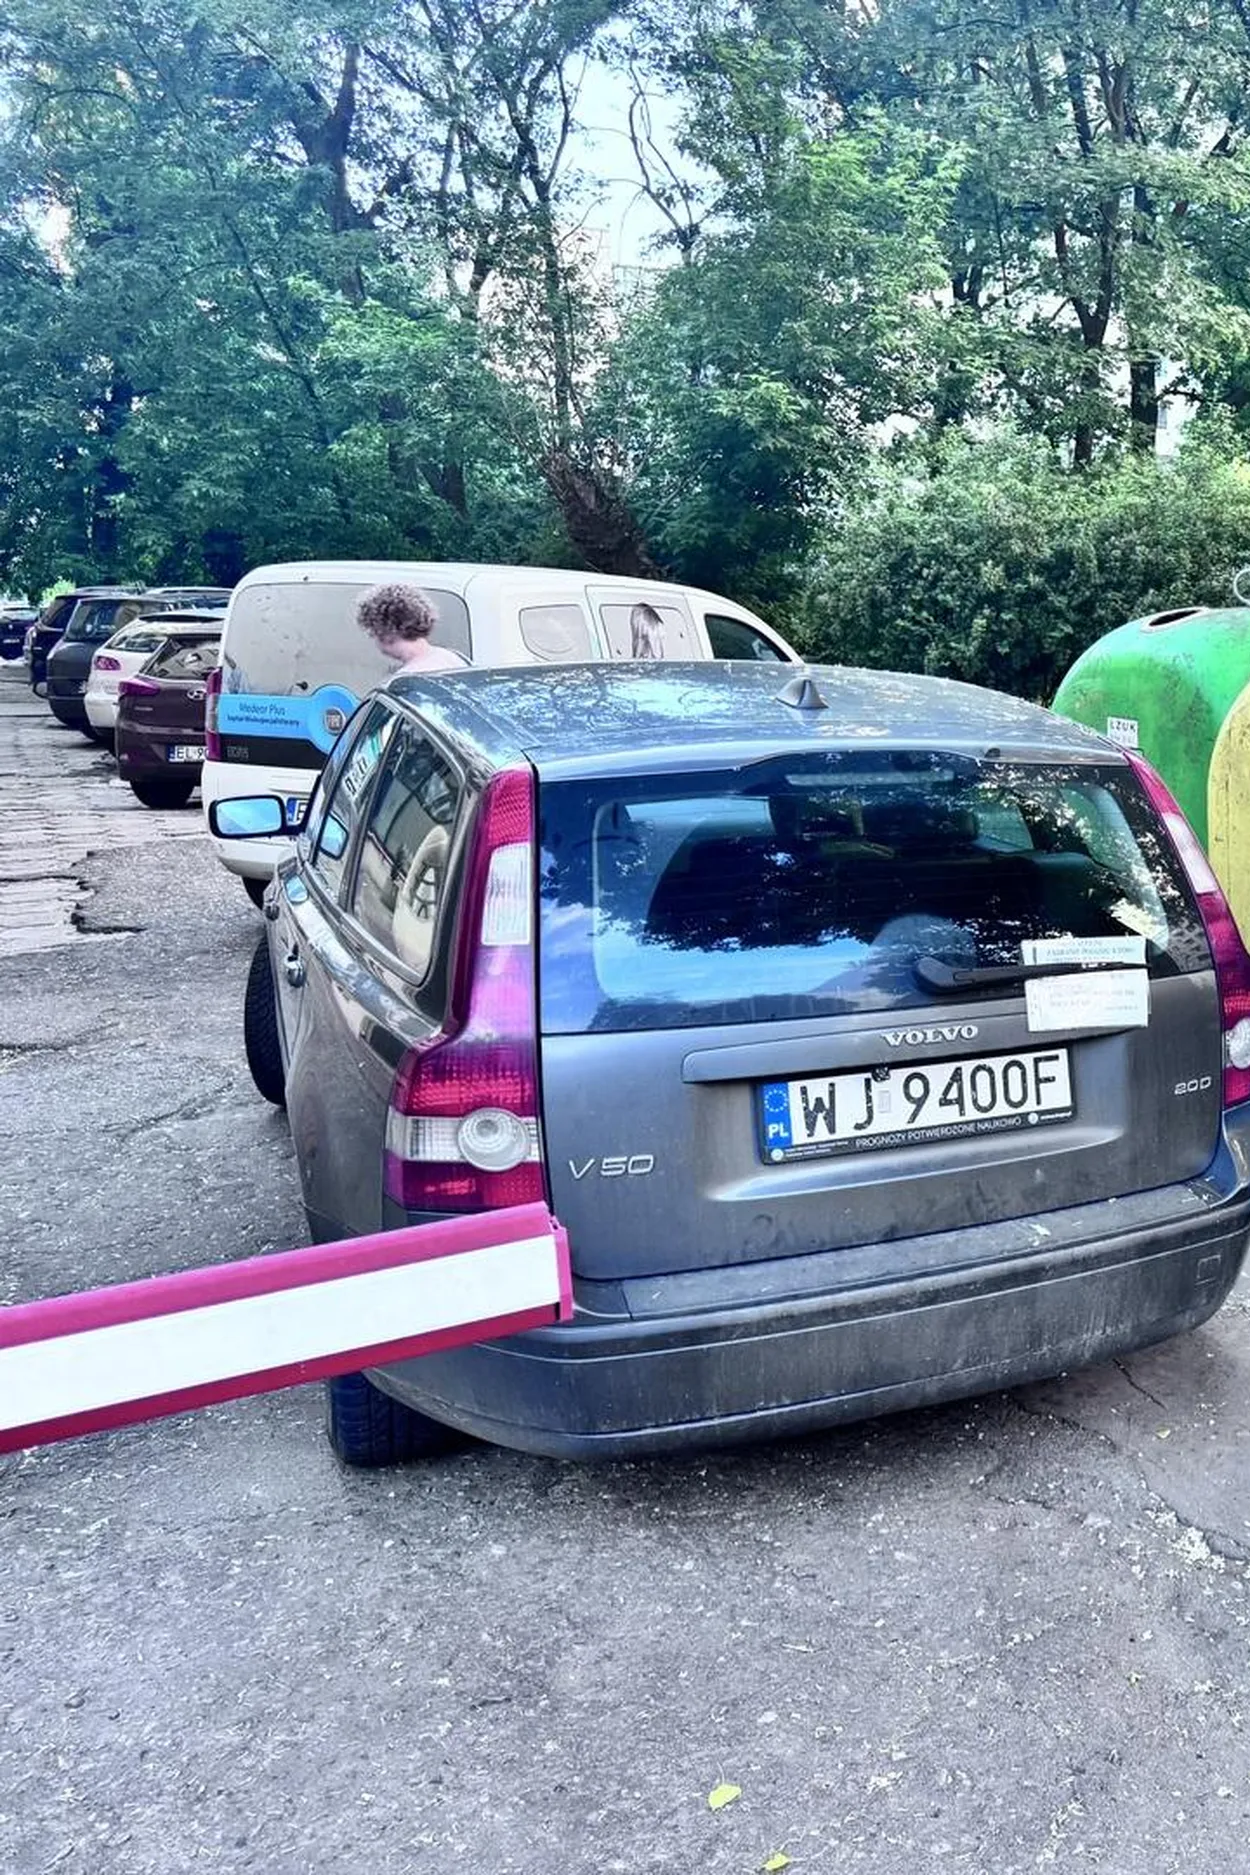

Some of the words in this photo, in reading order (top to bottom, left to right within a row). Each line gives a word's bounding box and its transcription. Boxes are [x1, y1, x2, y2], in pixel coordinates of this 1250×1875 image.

[881, 1024, 979, 1047] VOLVO
[768, 1122, 789, 1139] PL
[799, 1076, 875, 1138] WJ
[902, 1054, 1060, 1124] 9400F
[855, 1132, 905, 1149] PROGNOZY
[908, 1124, 975, 1141] POTWIERDZONE
[977, 1115, 1022, 1132] NAUKOWO
